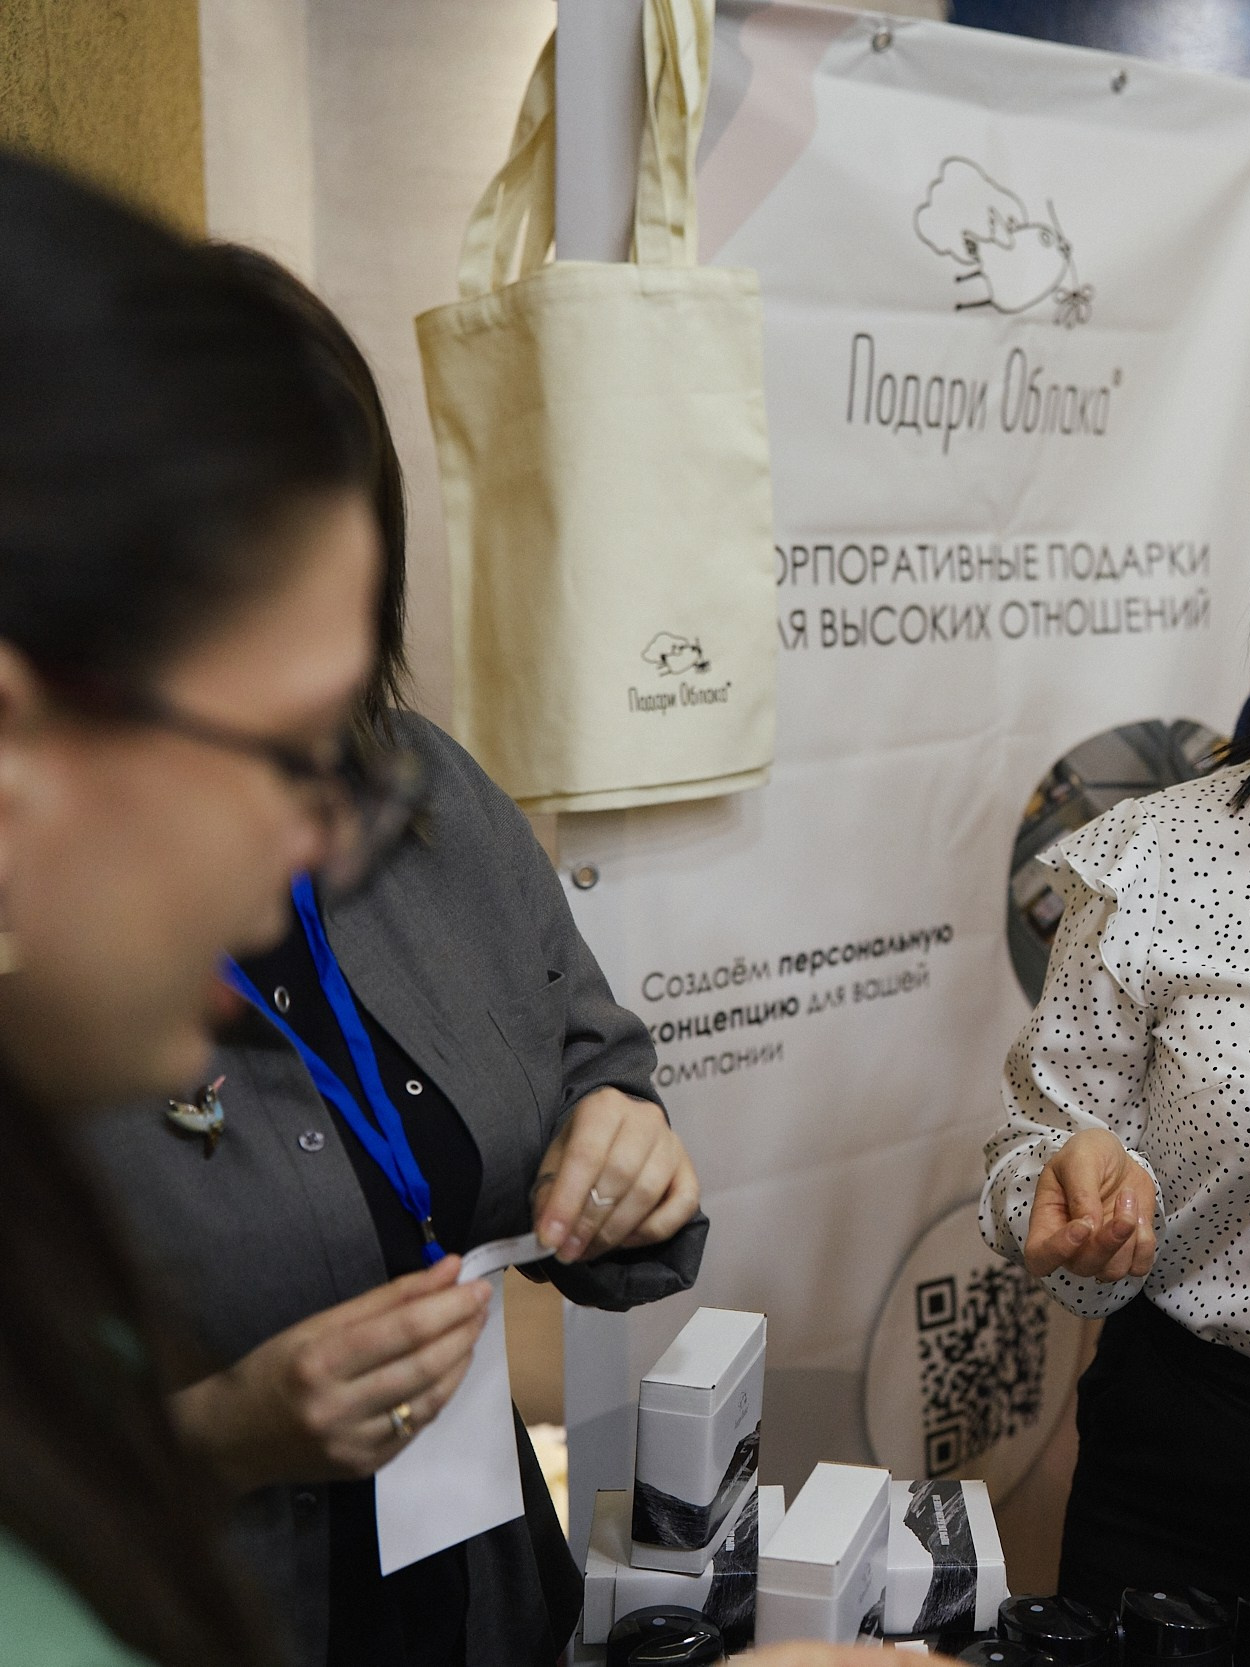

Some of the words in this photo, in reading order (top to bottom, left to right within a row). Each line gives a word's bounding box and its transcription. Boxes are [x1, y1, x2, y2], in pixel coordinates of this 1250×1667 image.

[847, 332, 988, 456] Подари
[774, 543, 1037, 587] РПОРАТИВНЫЕ
[1047, 541, 1211, 582] ПОДАРКИ
[820, 603, 991, 649] ВЫСОКИХ
[999, 588, 1211, 640] ОТНОШЕНИЙ
[641, 957, 771, 1002] Создаём
[778, 923, 954, 978] персональную
[807, 985, 846, 1015] для
[853, 962, 931, 1004] вашей
[655, 1041, 784, 1088] омпании
